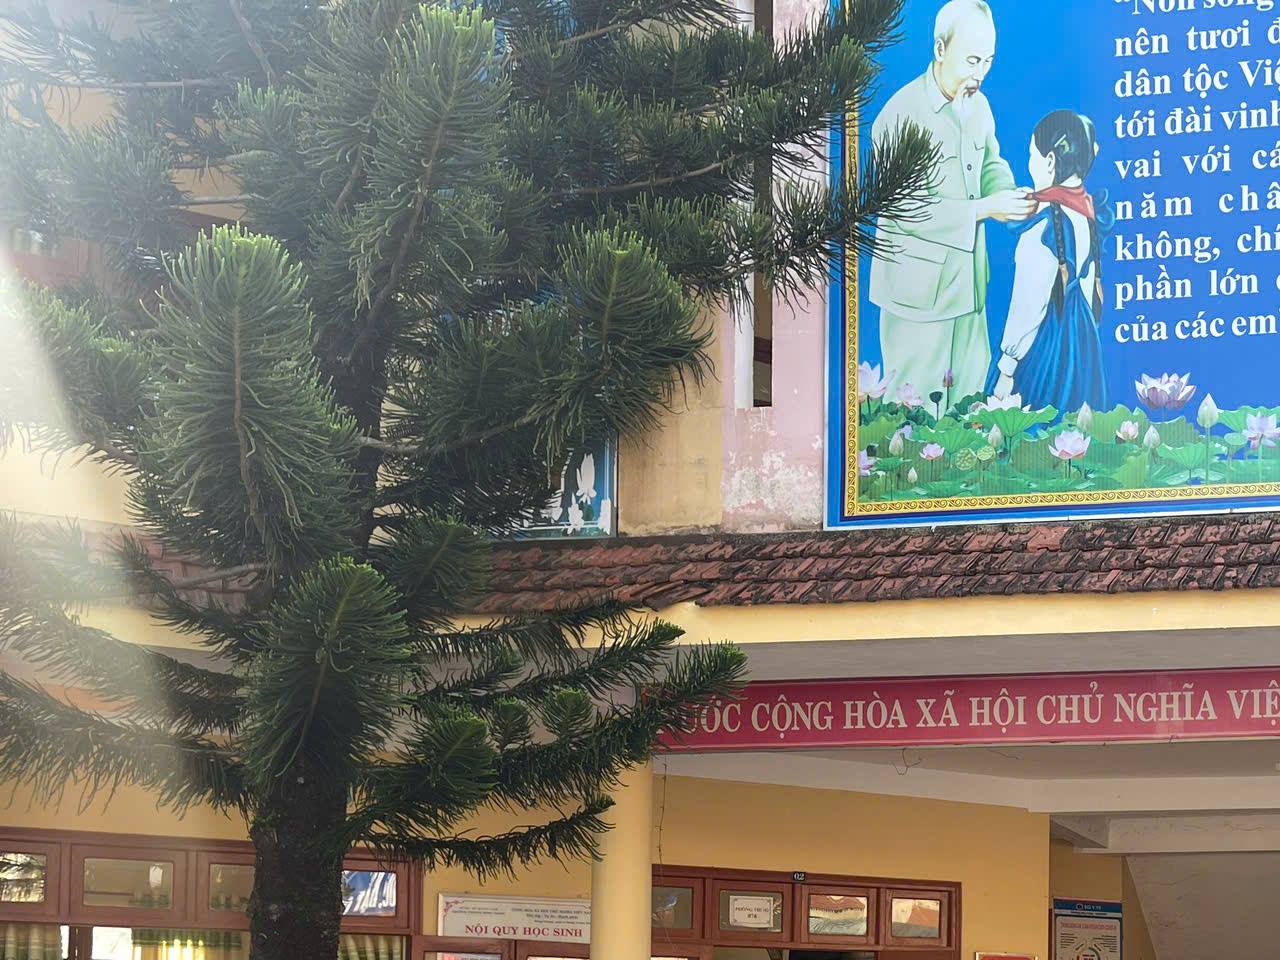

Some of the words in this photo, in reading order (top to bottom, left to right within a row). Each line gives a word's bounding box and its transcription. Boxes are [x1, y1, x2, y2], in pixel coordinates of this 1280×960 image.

[1115, 27, 1169, 57] nên
[1186, 19, 1251, 51] tươi
[1114, 68, 1171, 98] dân
[1182, 63, 1228, 99] tộc
[1114, 109, 1156, 139] tới
[1164, 104, 1212, 135] đài
[1114, 150, 1161, 179] vai
[1182, 144, 1231, 174] với
[1115, 191, 1193, 220] năm
[1115, 230, 1221, 263] không,
[1115, 264, 1192, 310] phần
[1210, 266, 1259, 297] lớn
[1115, 312, 1169, 343] của
[1175, 311, 1225, 340] các
[751, 694, 834, 739] CỘNG
[843, 691, 908, 729] HÒA
[916, 690, 960, 728] XÃ
[969, 687, 1027, 734] HỘI
[1036, 681, 1104, 725] CHỦ
[1113, 684, 1218, 723] NGHĨA
[465, 923, 488, 936] NỘI
[492, 926, 519, 937] QUY
[523, 927, 549, 938] HỌC
[553, 928, 582, 937] SINH
